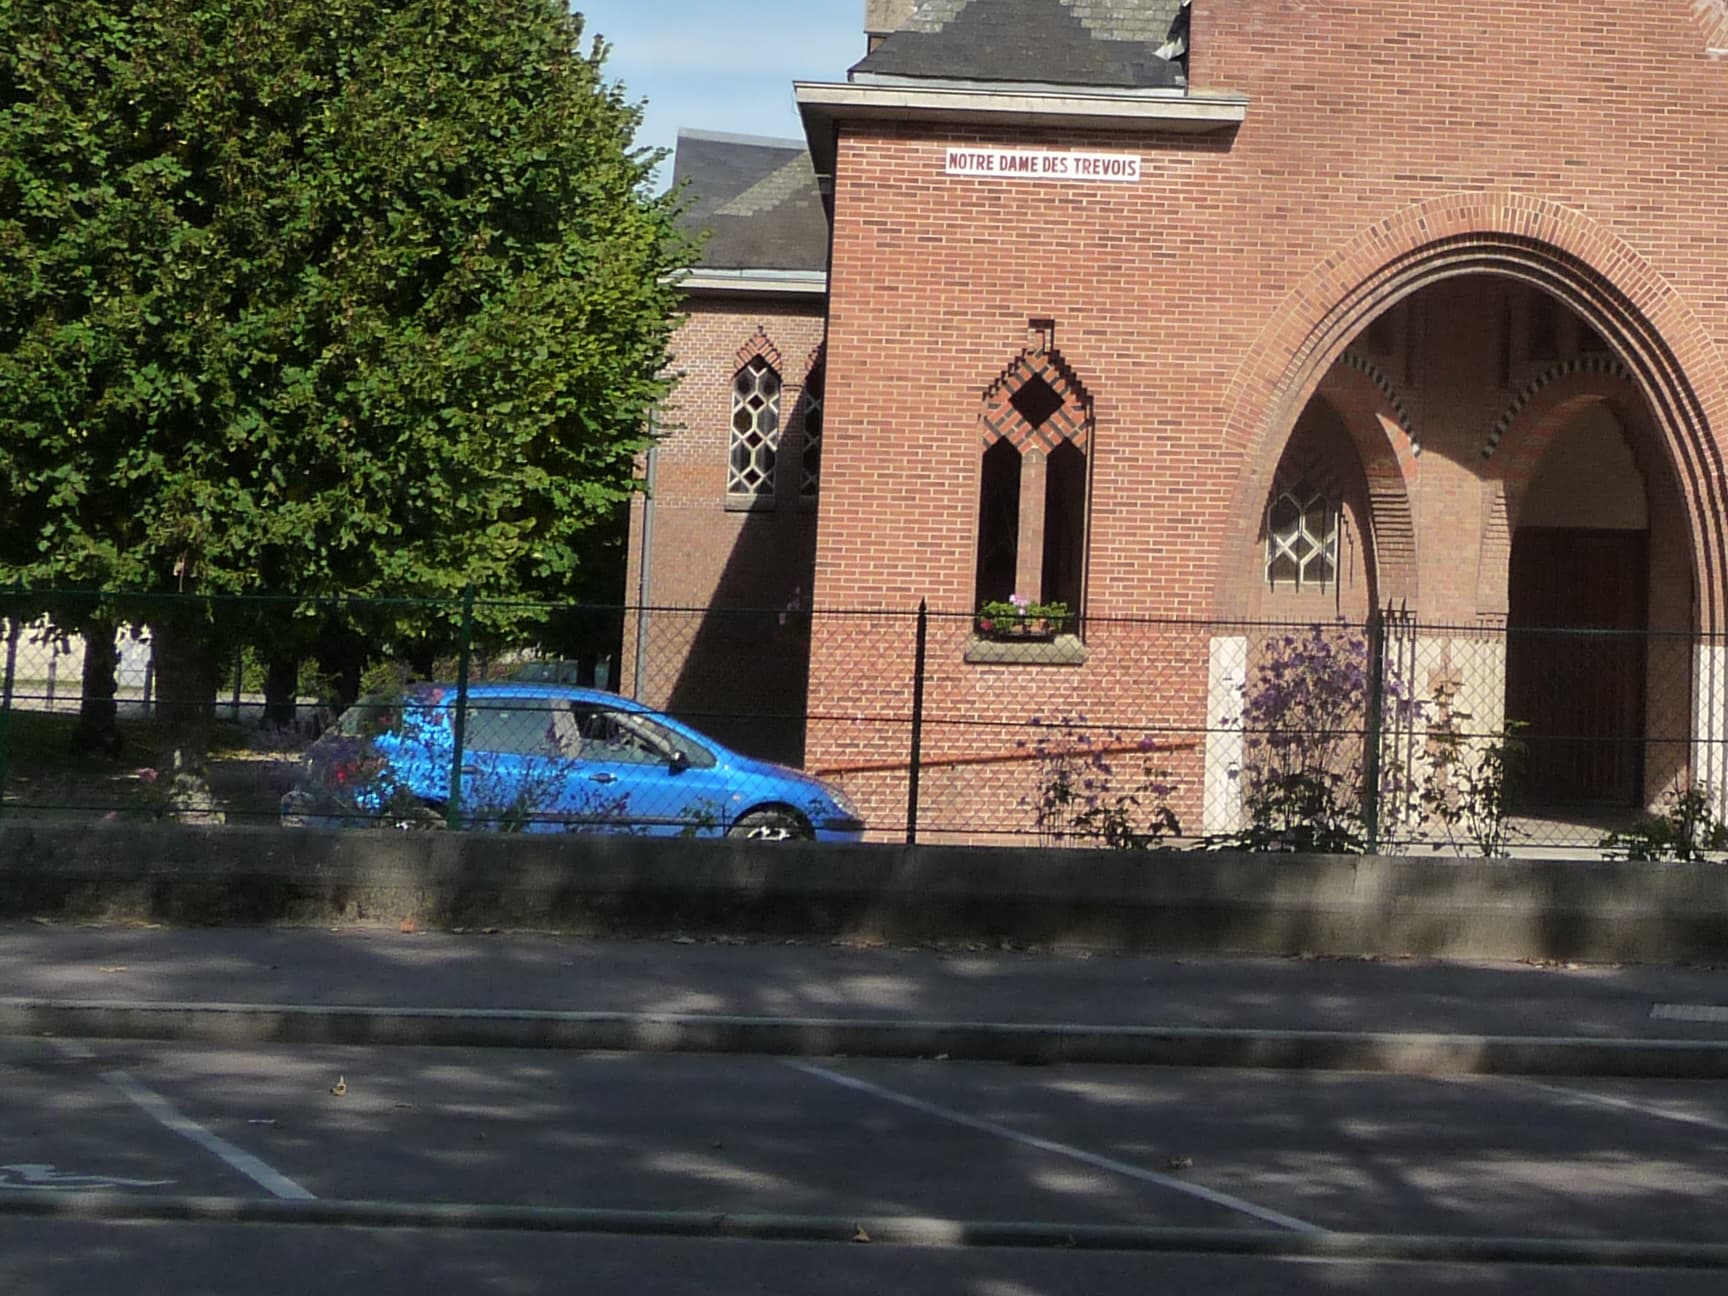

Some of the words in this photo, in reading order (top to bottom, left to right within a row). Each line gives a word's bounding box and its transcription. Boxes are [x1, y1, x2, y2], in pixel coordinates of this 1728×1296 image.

[949, 152, 994, 171] NOTRE
[999, 155, 1038, 173] DAME
[1042, 156, 1068, 173] DES
[1074, 158, 1137, 176] TREVOIS
